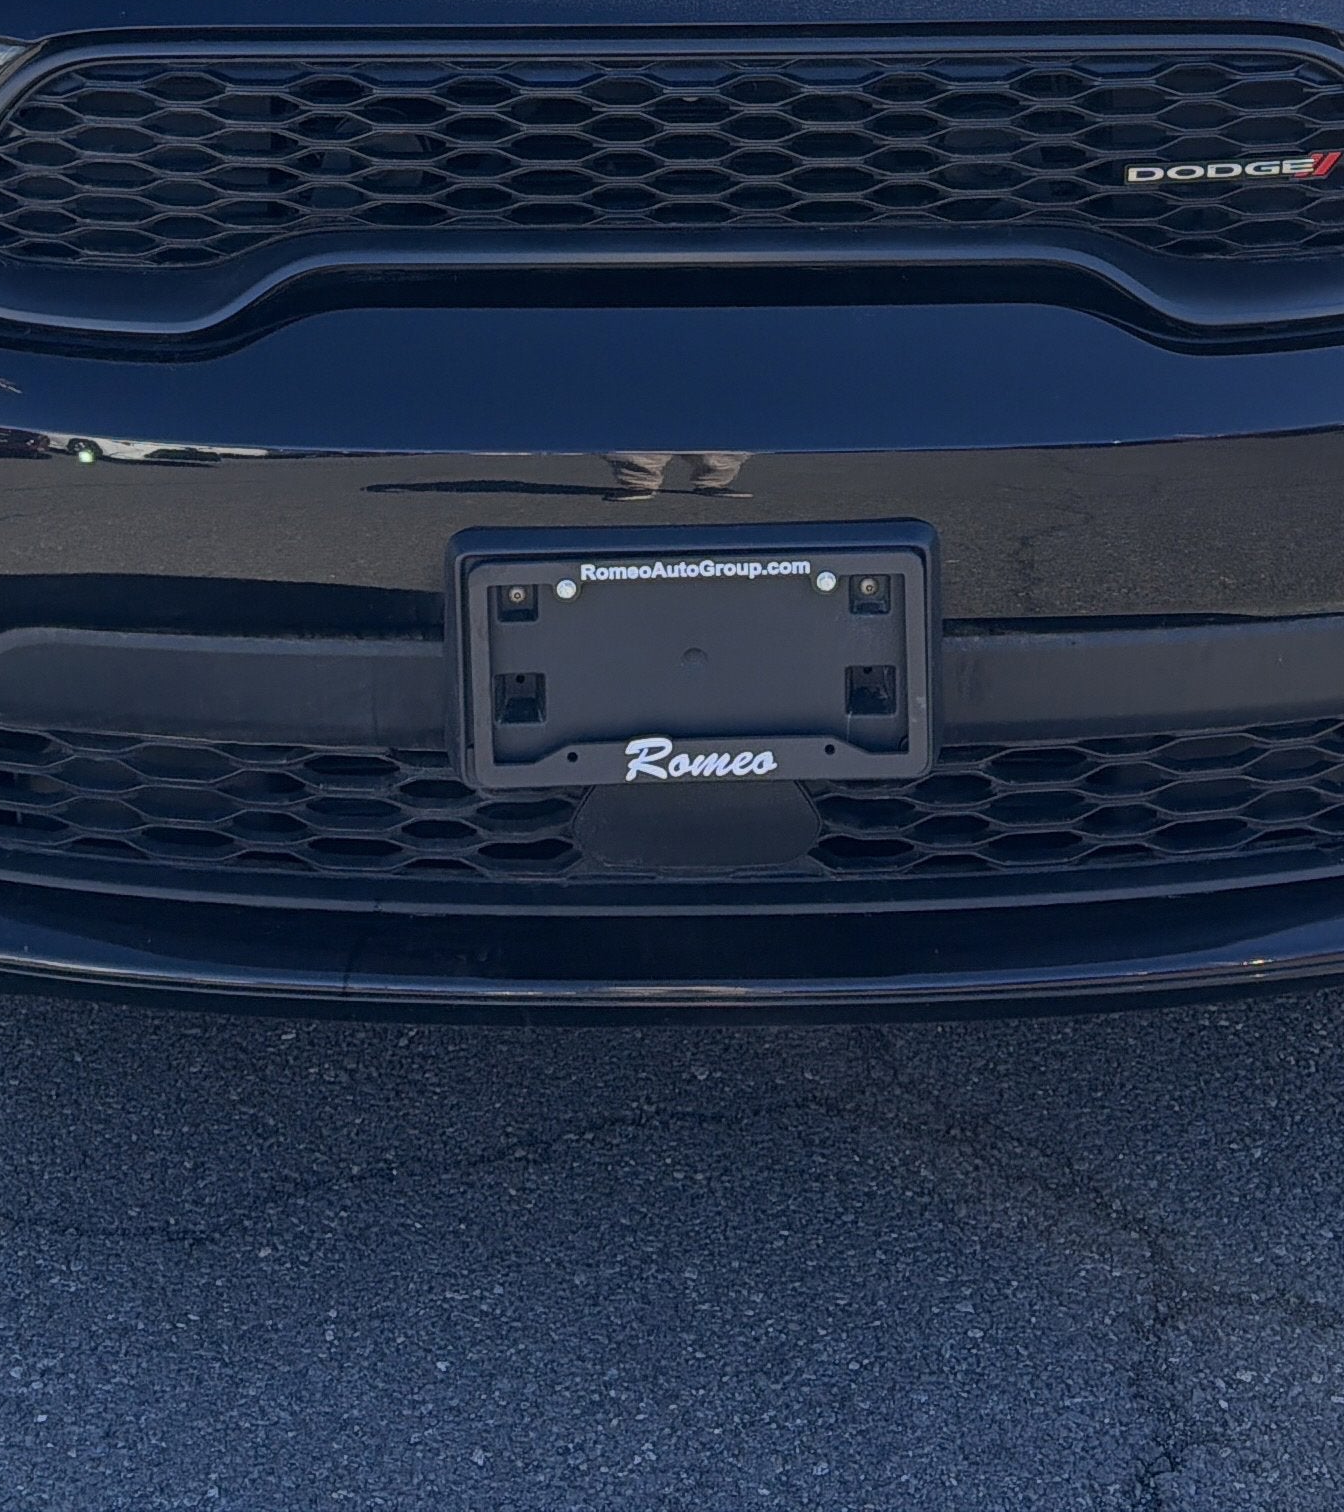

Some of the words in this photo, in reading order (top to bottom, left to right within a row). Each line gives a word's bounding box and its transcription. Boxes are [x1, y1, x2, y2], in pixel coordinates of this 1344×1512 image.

[1127, 158, 1316, 183] DODGE
[580, 559, 811, 581] RomeoAutoGroup.com
[624, 737, 778, 782] Romeo
